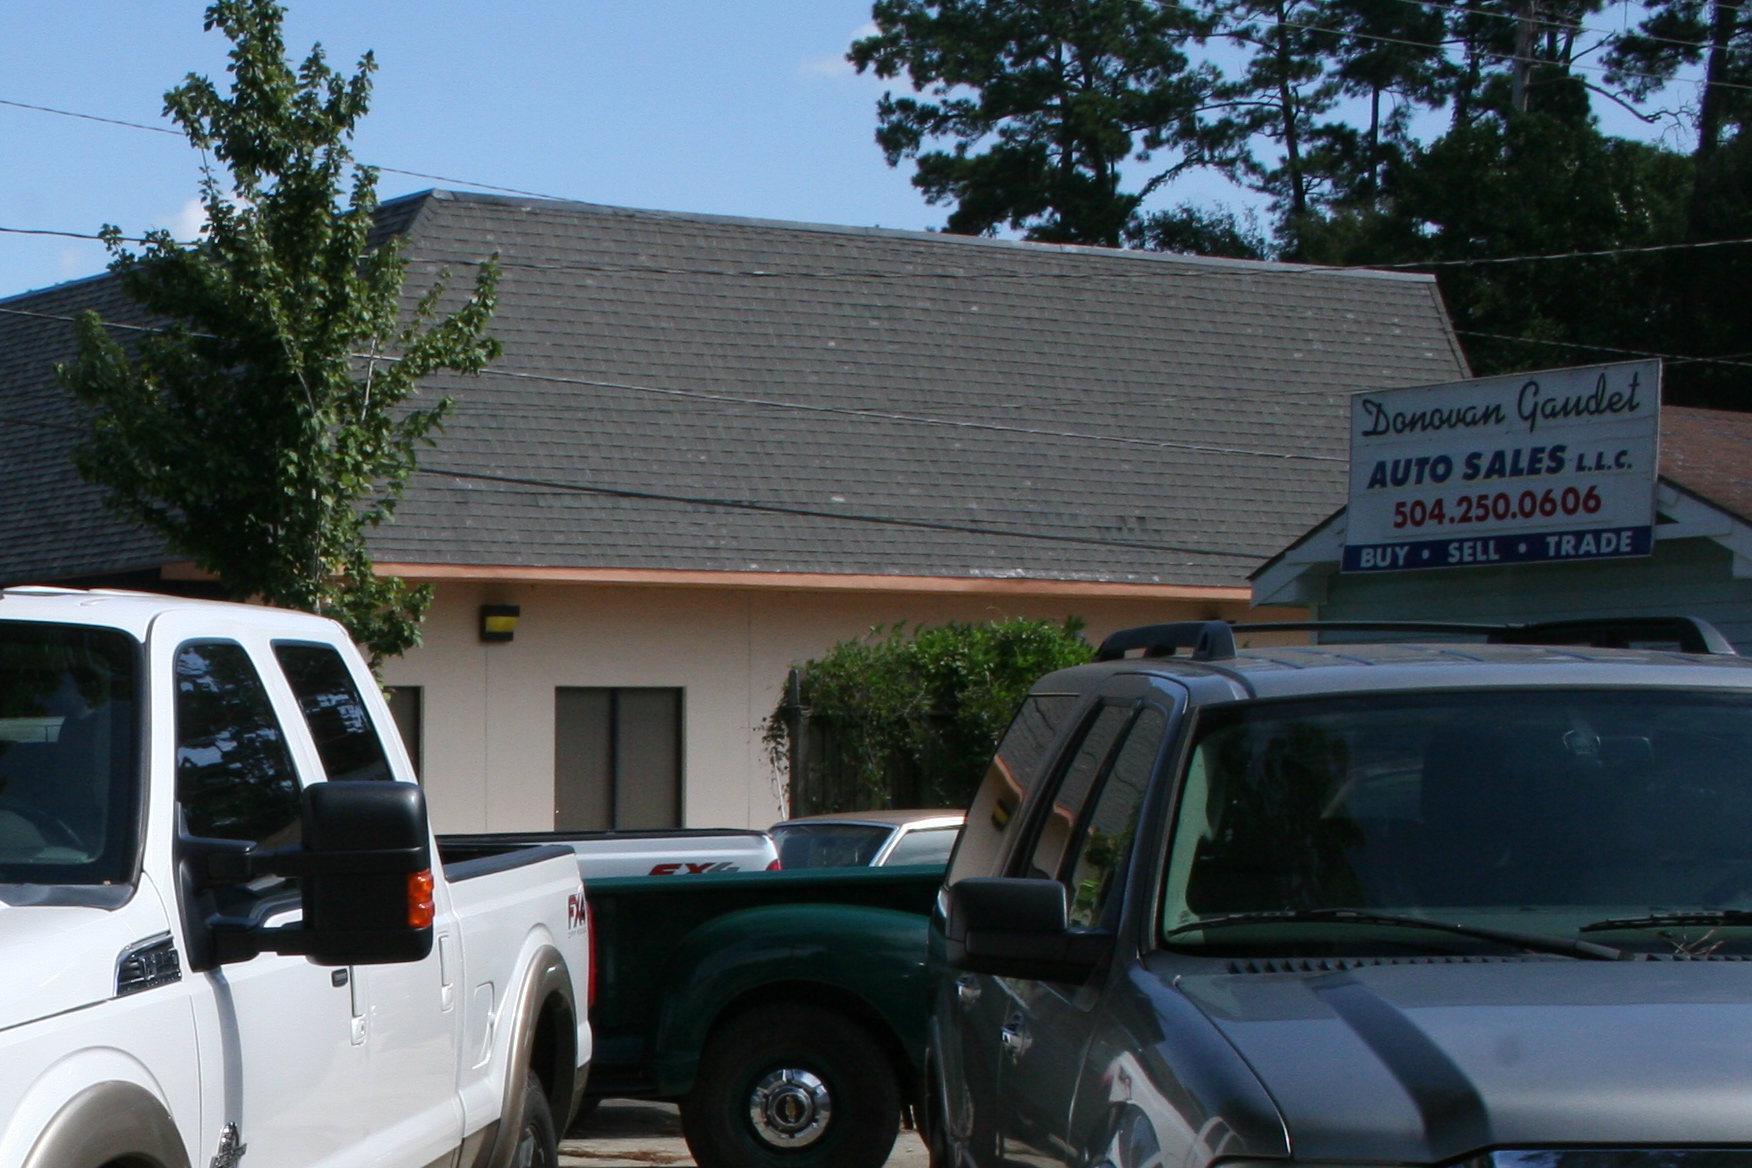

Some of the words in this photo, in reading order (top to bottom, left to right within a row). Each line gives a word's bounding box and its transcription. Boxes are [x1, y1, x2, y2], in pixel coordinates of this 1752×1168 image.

[1361, 398, 1506, 437] Donovan
[1517, 371, 1641, 434] Gaudet
[1367, 455, 1453, 489] AUTO
[1462, 444, 1567, 481] SALES
[1575, 450, 1632, 472] L.L.C.
[1393, 485, 1602, 529] 504.250.0606
[1360, 545, 1410, 568] BUY
[1448, 540, 1500, 563] SELL
[1546, 530, 1633, 557] TRADE
